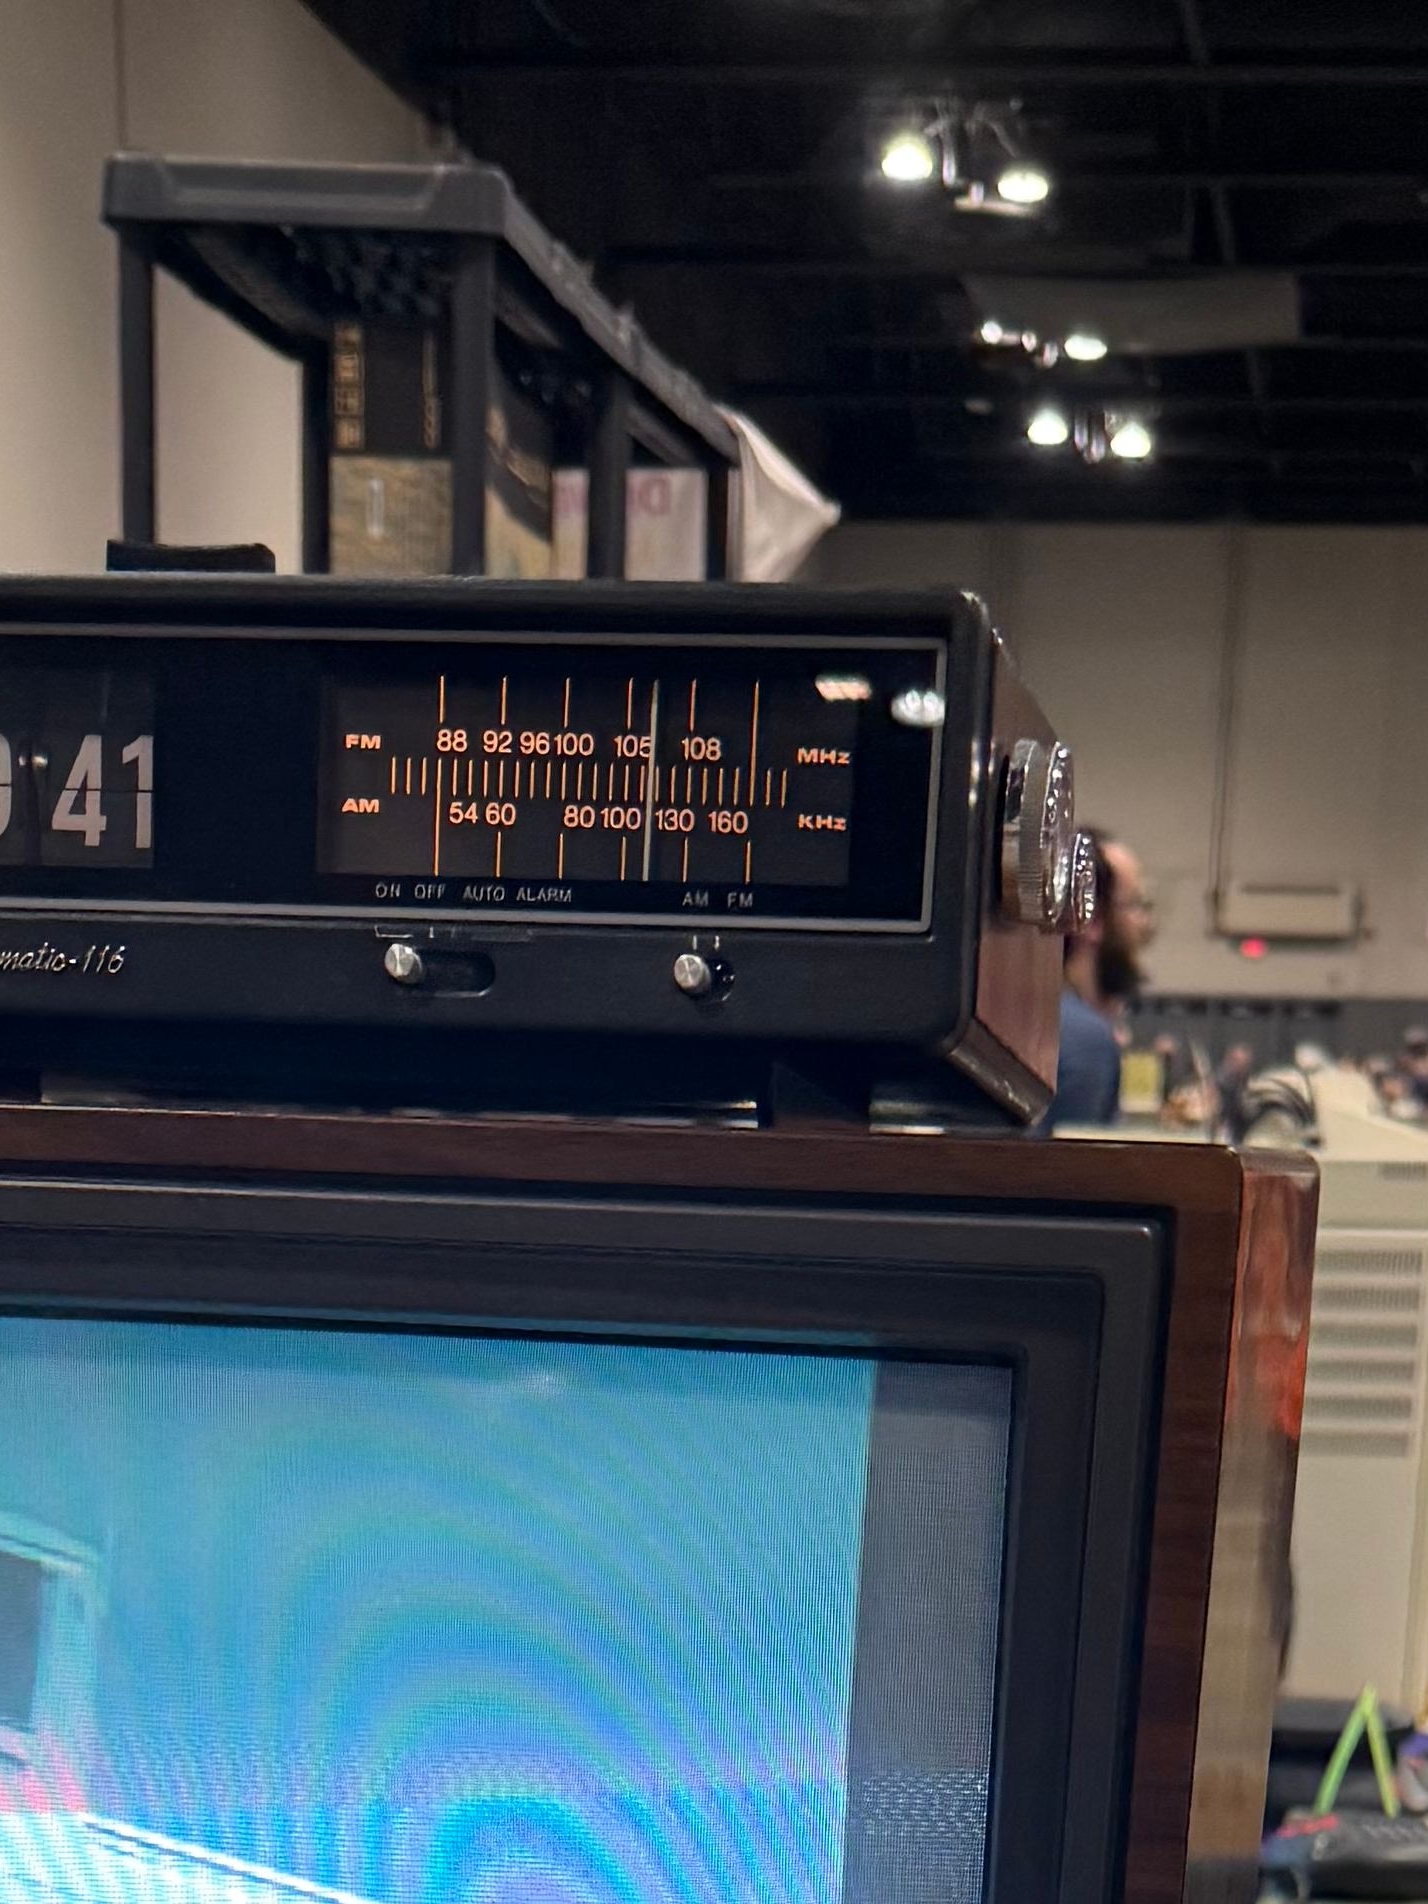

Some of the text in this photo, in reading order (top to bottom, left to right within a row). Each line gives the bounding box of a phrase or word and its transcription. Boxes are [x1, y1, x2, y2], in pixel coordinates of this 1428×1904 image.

[344, 728, 852, 766] FM 88 92 96 100 105 108 MHz
[51, 734, 155, 850] 41
[342, 798, 848, 835] AM 54 60 80 100 130 160 KHz
[374, 882, 572, 903] ON OFF AUTO ALARM
[681, 891, 754, 908] AM FM
